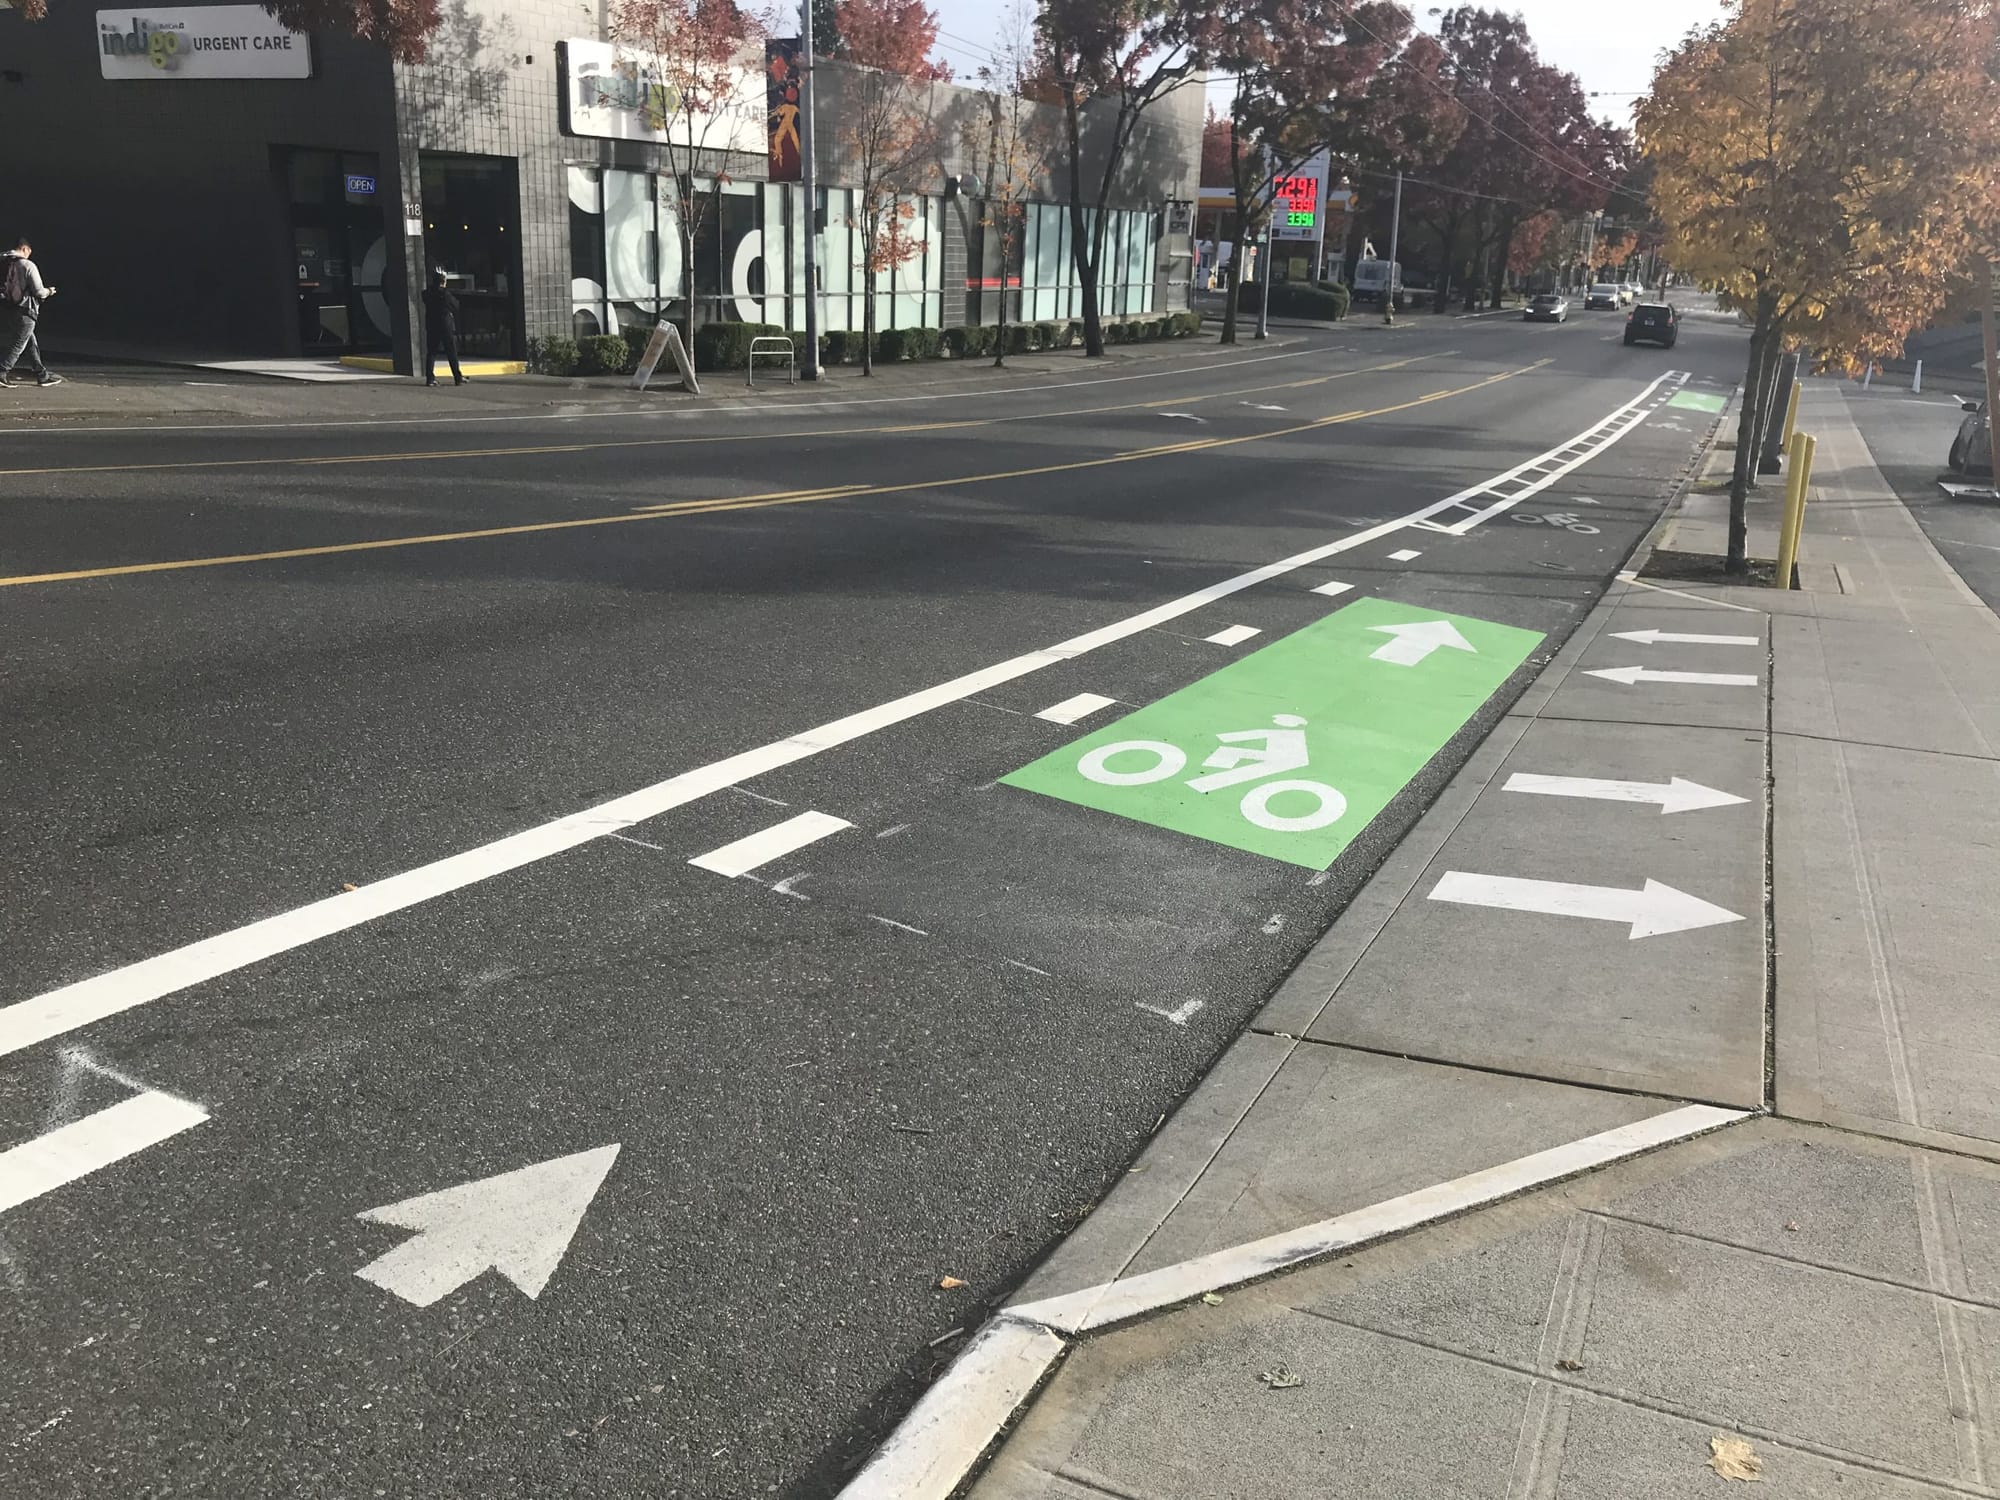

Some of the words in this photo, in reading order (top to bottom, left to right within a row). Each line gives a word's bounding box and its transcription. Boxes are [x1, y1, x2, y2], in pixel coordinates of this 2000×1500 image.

[102, 17, 178, 70] indigo
[193, 36, 248, 51] URGENT
[253, 35, 291, 50] CARE
[350, 179, 373, 191] OPEN
[405, 203, 421, 216] 118
